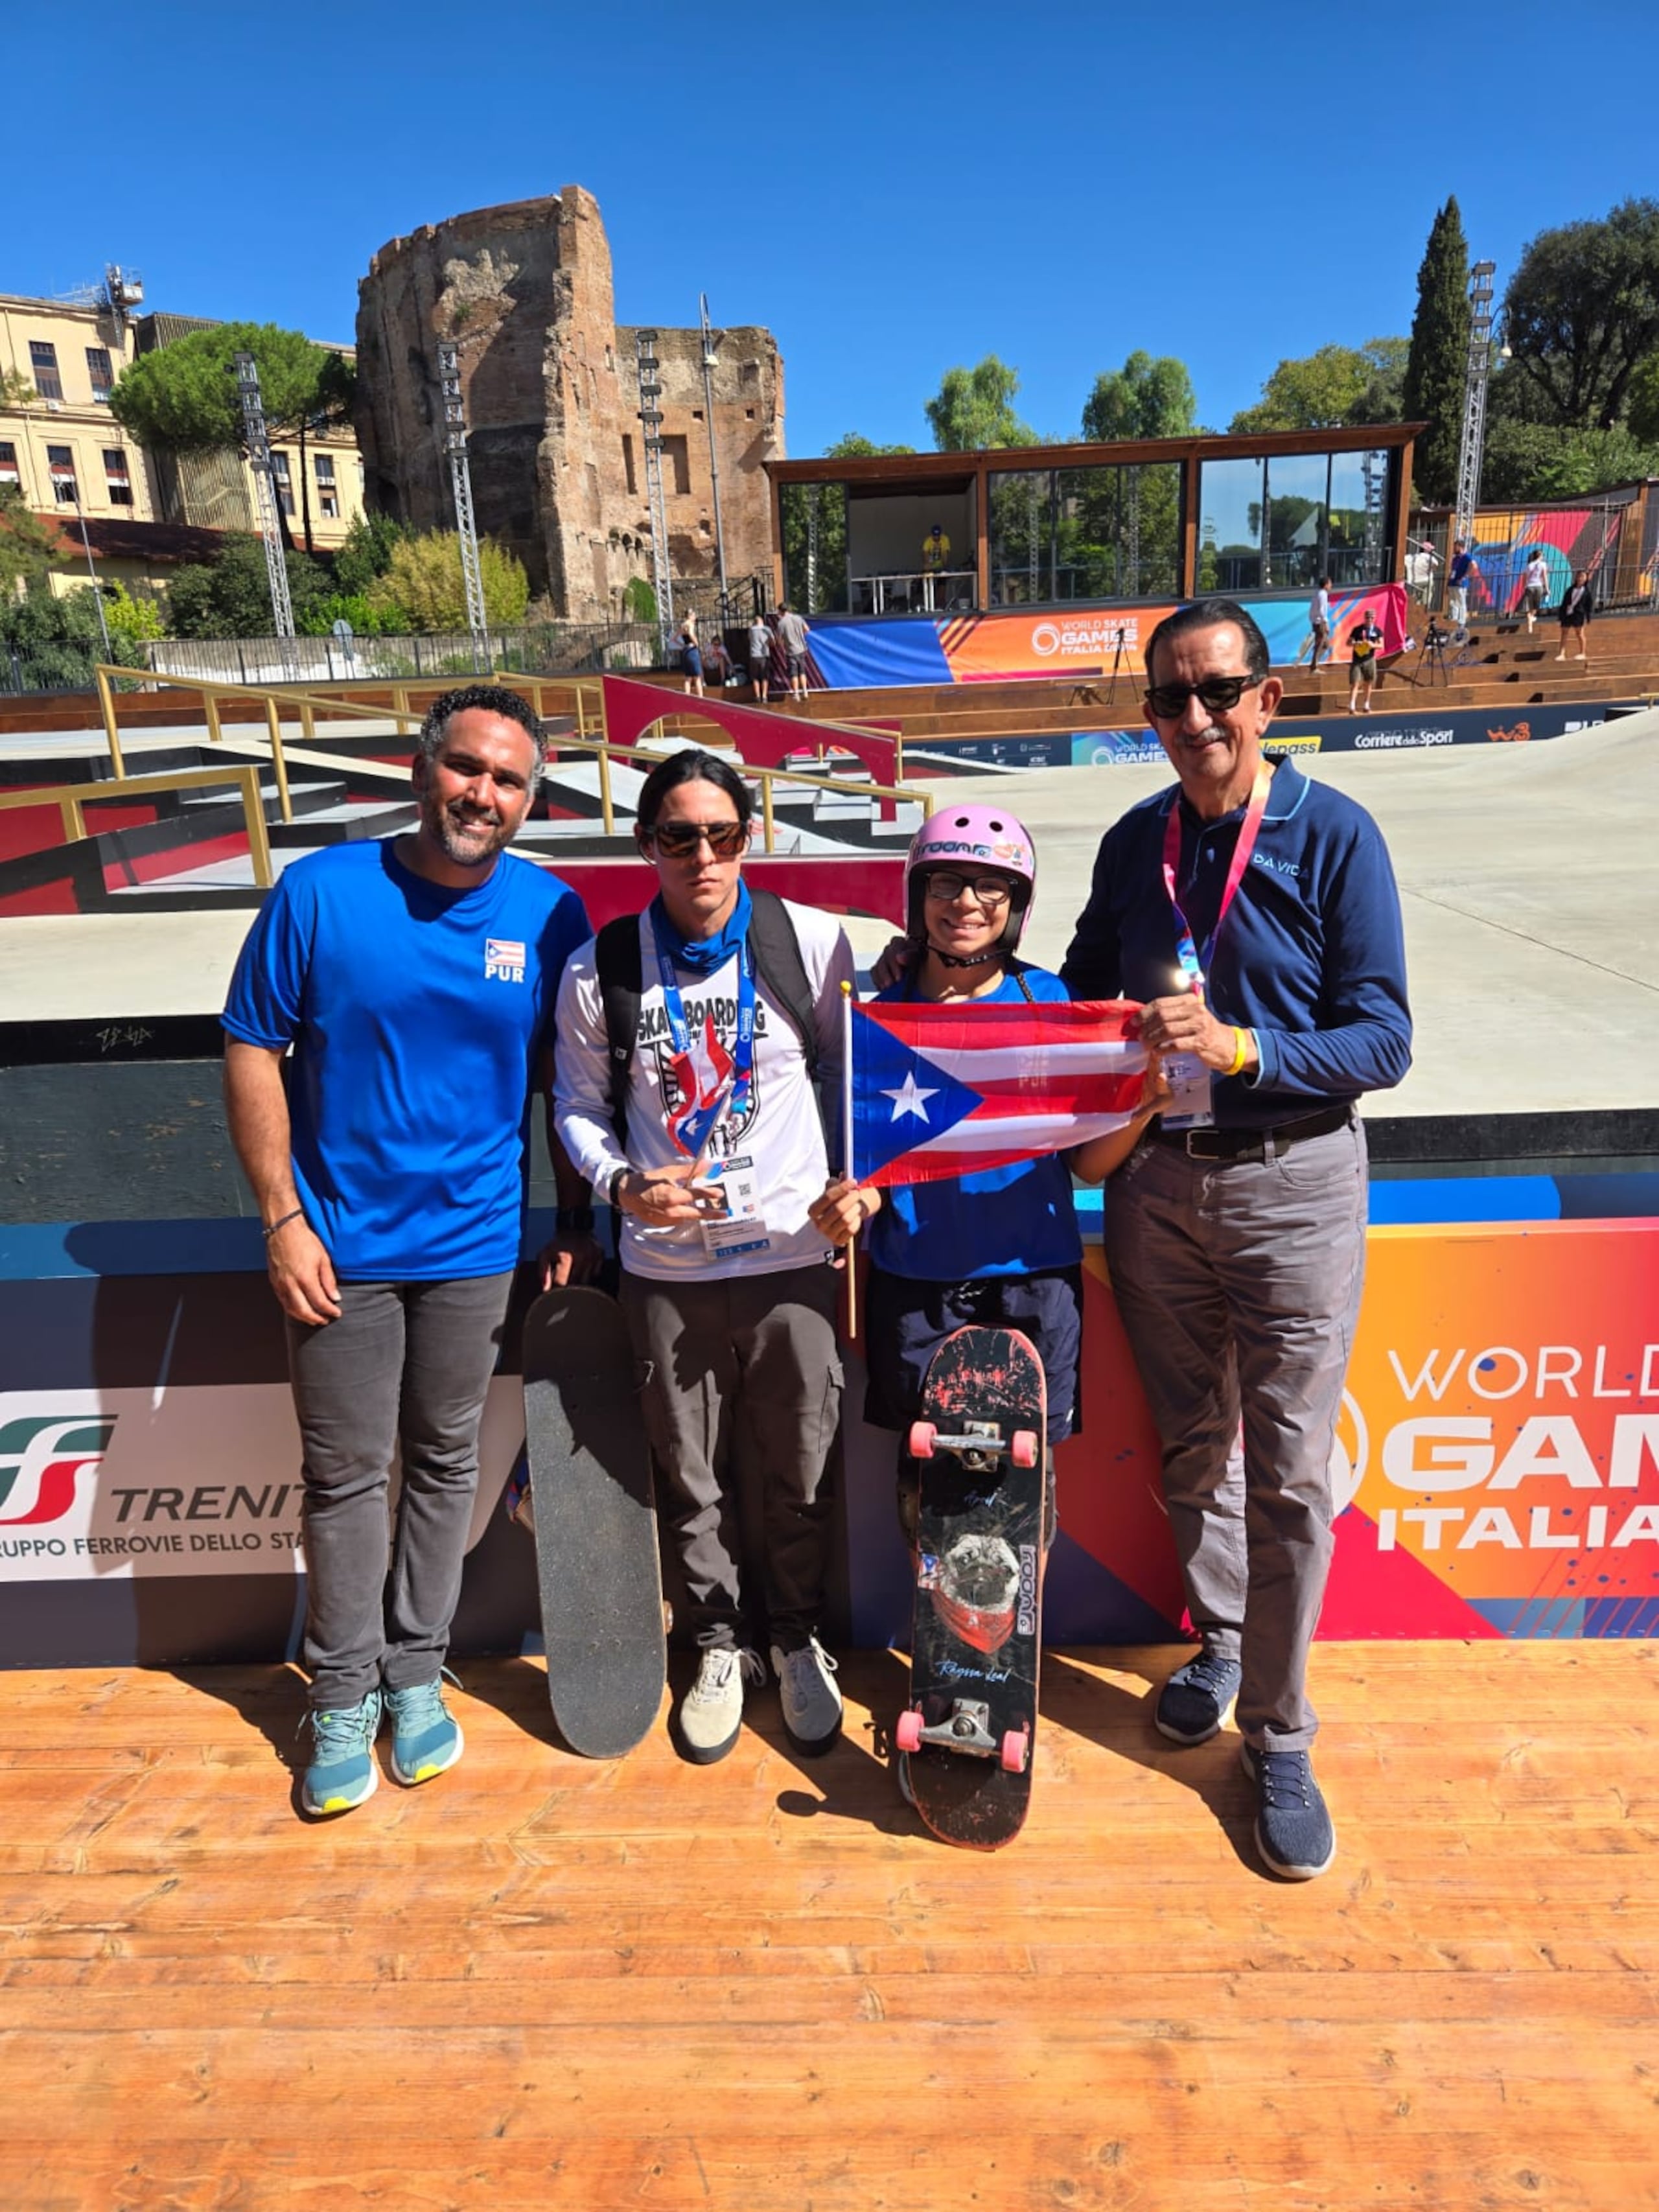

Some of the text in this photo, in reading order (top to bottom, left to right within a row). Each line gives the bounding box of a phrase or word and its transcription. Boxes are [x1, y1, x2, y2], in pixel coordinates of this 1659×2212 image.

[1062, 618, 1138, 631] WORLD SKATE
[1061, 629, 1138, 645] GAMES
[1061, 644, 1101, 655] ITALIA
[1355, 733, 1402, 748] Corriere
[1420, 730, 1454, 747] Sport
[1115, 744, 1148, 752] WORLD
[1263, 742, 1317, 754] lepass
[485, 964, 524, 983] PUR
[1378, 1505, 1659, 1551] ITALIA
[0, 1538, 66, 1557] UPPO
[74, 1535, 183, 1554] FERROVIE
[190, 1533, 262, 1552] DELLO
